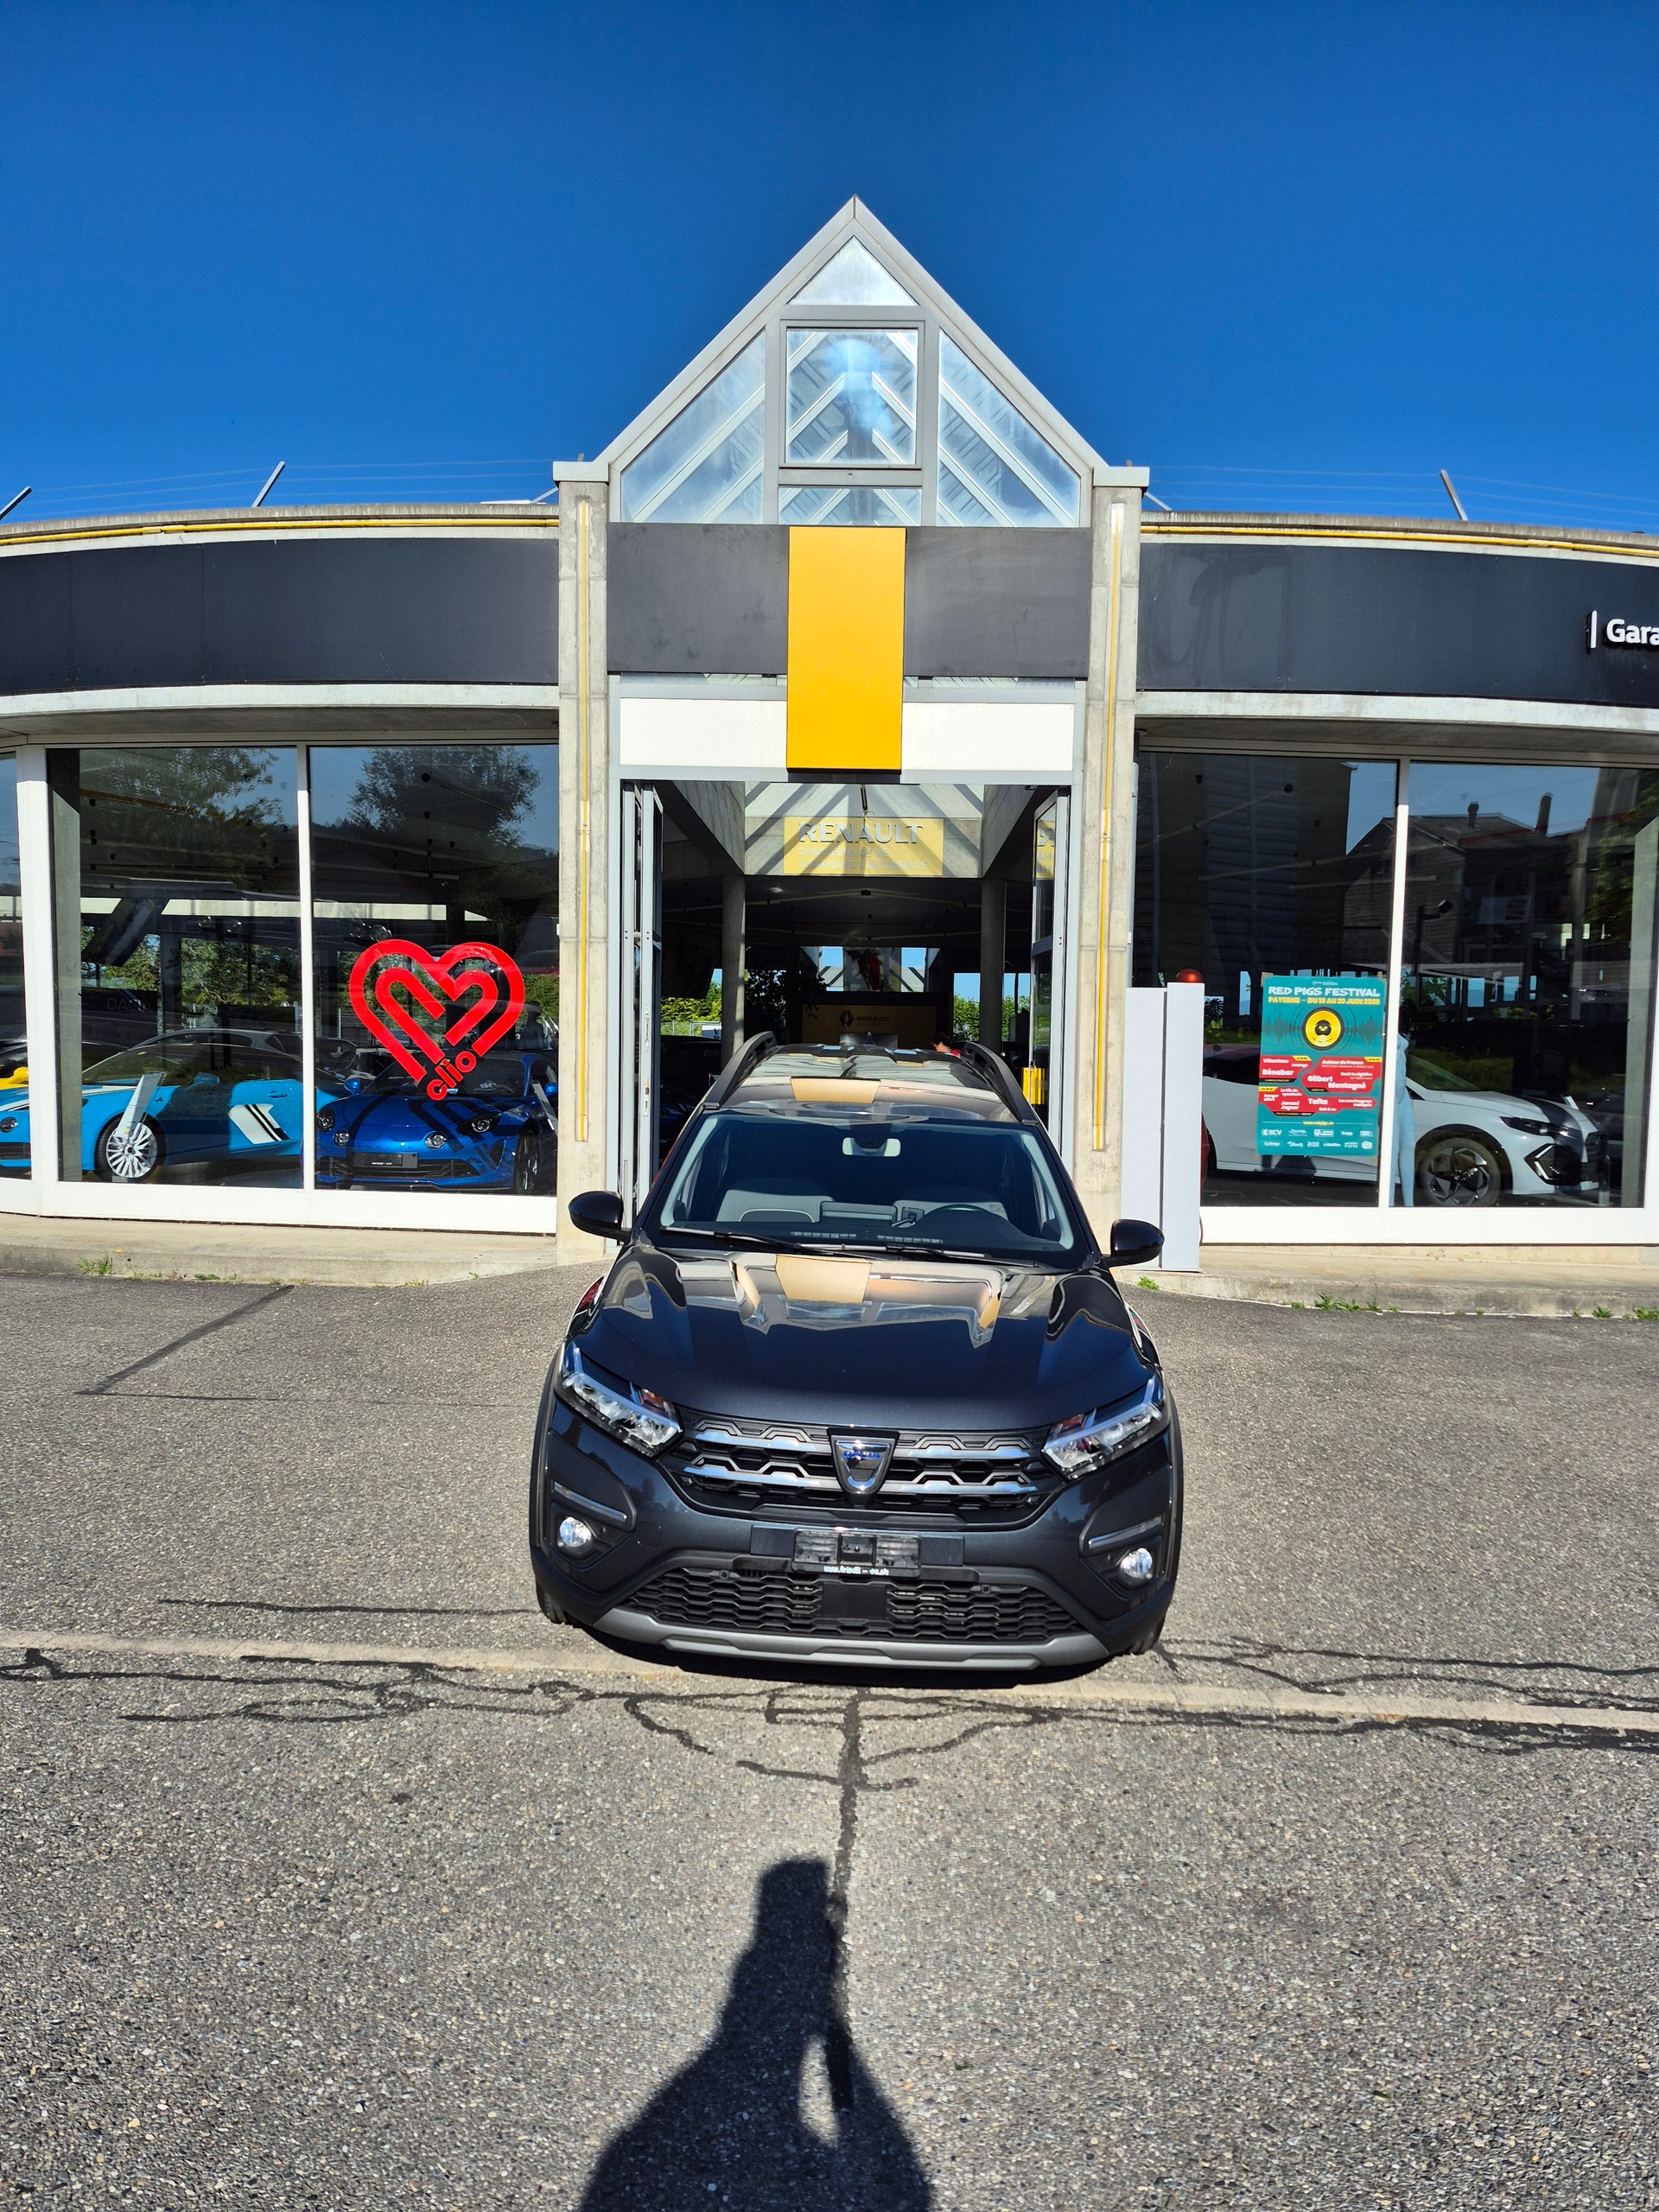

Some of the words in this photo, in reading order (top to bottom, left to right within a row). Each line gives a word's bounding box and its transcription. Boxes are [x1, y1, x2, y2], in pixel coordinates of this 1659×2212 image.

[799, 823, 924, 843] RENAULT
[1268, 986, 1293, 995] RED
[1294, 987, 1323, 996] PIGS
[1325, 988, 1381, 997] FESTIVAL
[106, 998, 151, 1012] DACA
[427, 1051, 477, 1101] clio
[1328, 1082, 1366, 1090] Montagné
[843, 1451, 880, 1459] DACIA
